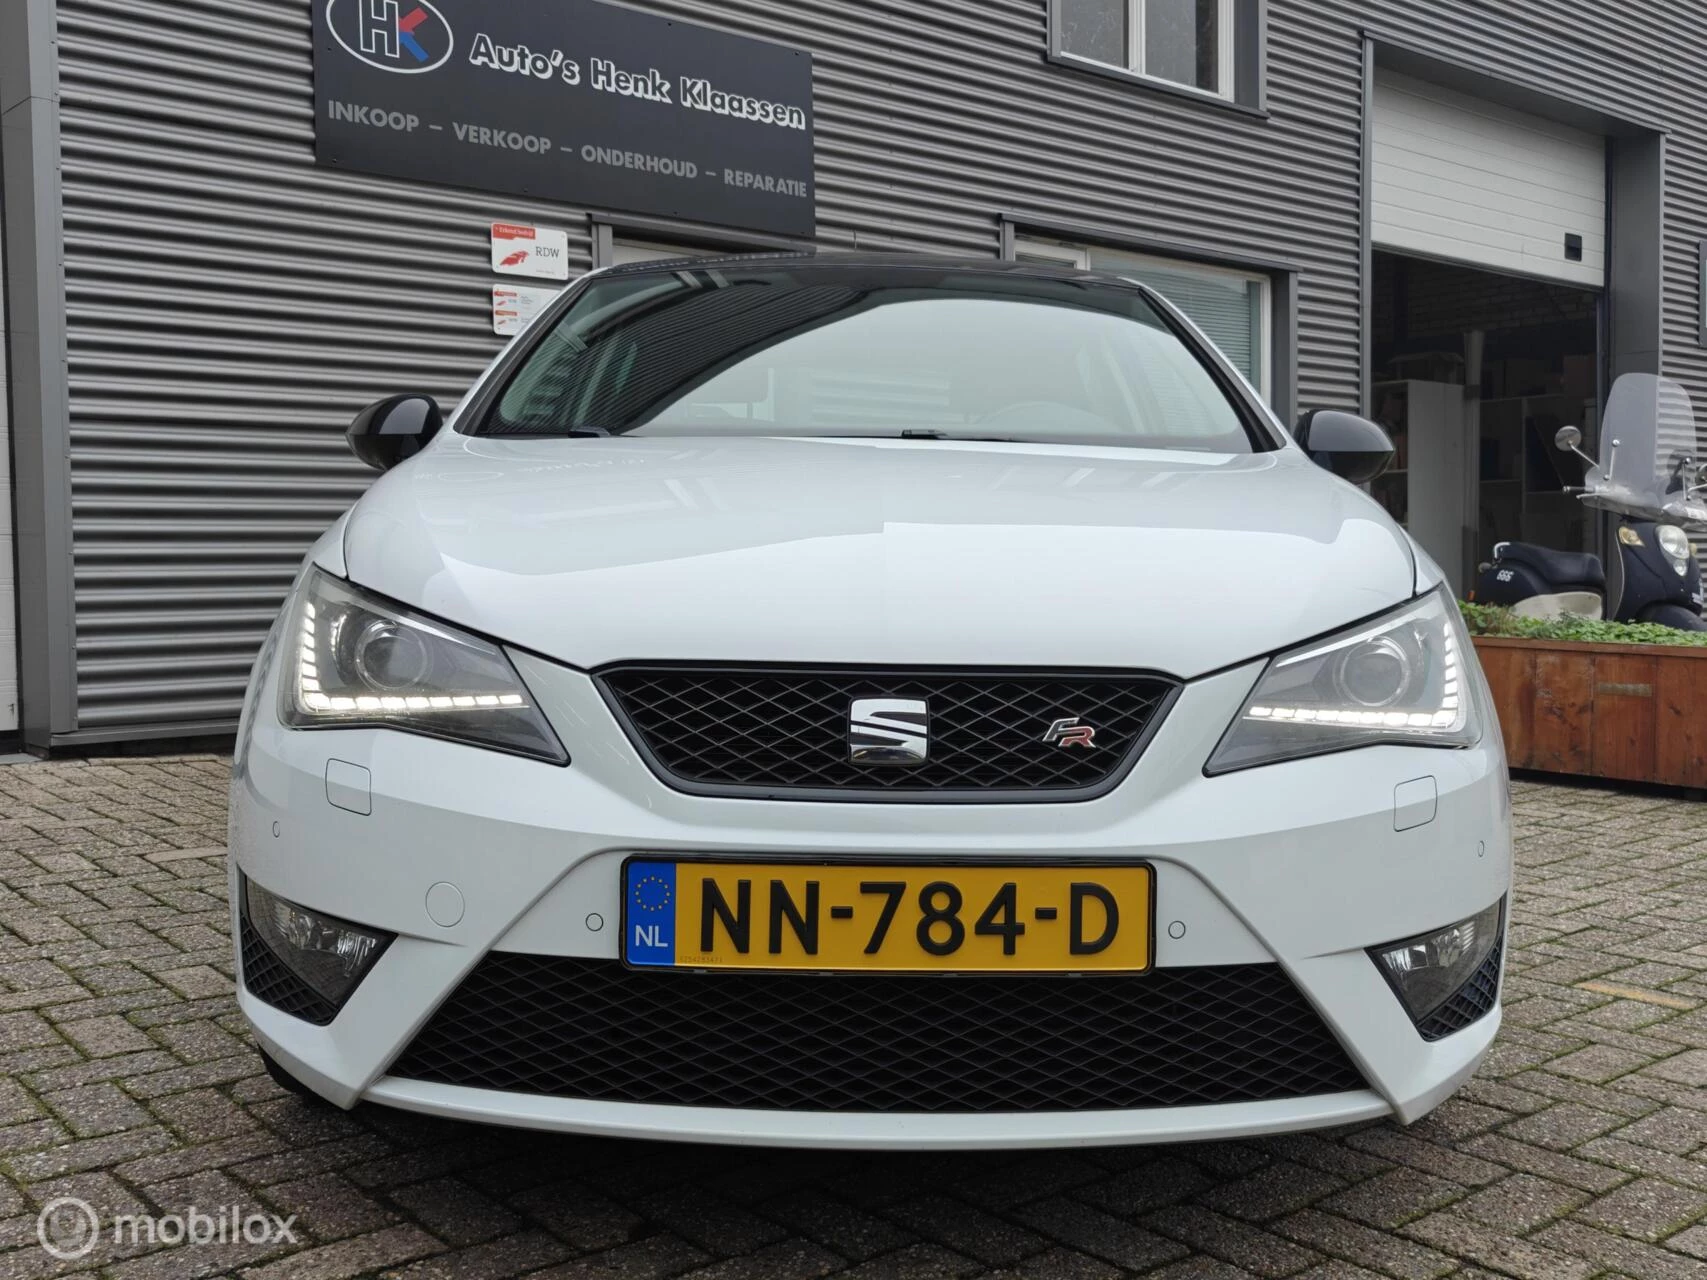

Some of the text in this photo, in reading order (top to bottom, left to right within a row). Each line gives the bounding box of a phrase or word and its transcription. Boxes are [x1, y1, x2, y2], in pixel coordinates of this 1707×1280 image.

[469, 33, 806, 130] Auto's Henk Klaassen
[328, 100, 420, 132] INKOOP
[452, 122, 551, 154] VERKOOP
[581, 145, 698, 179] ONDERHOUD
[724, 168, 807, 197] REPARATIE
[535, 246, 560, 259] RDW
[1042, 717, 1096, 748] FR
[635, 925, 669, 947] NL
[701, 878, 1119, 956] NN-784-D
